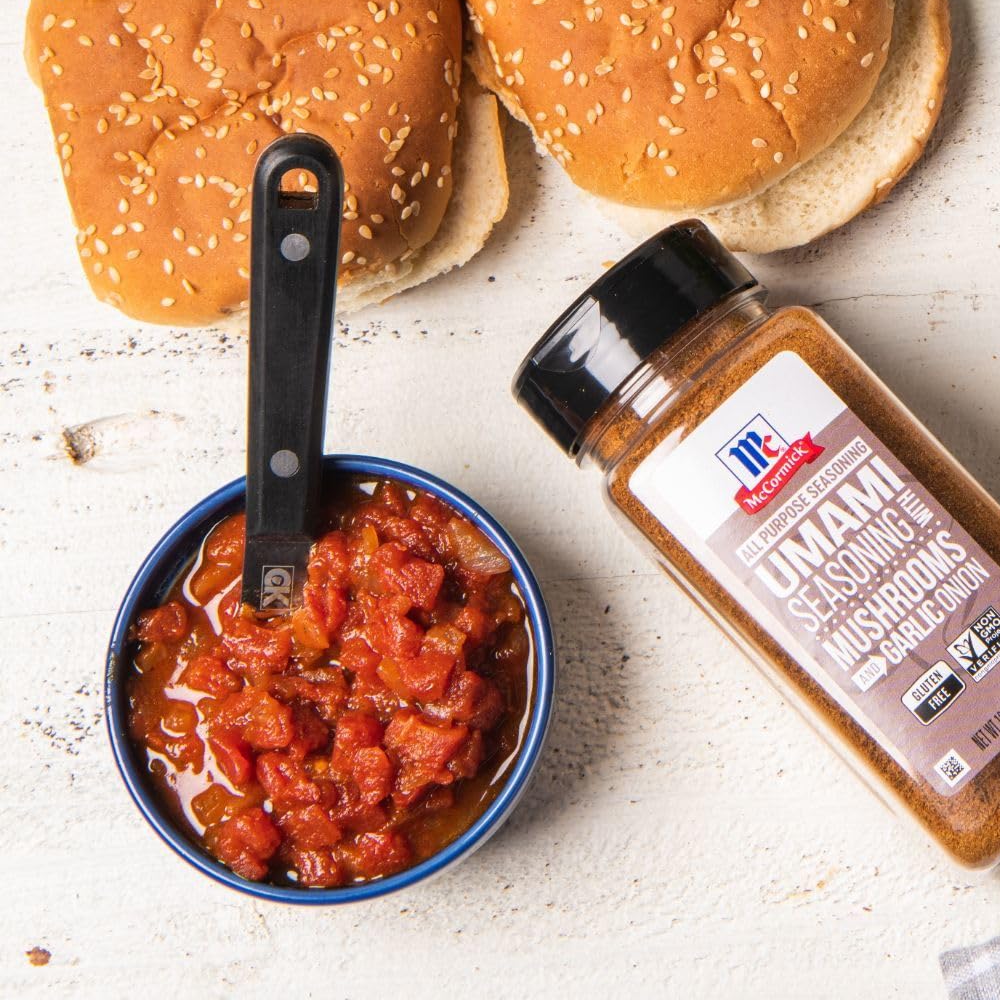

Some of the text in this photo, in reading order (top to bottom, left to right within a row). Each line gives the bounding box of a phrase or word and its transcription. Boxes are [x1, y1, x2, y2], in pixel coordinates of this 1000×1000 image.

[743, 442, 809, 509] McCormick
[742, 440, 868, 562] ALL PURPOSE SEASONING
[896, 489, 934, 528] WITH
[754, 455, 905, 598] UMAMI
[787, 508, 914, 633] SEASONING
[821, 530, 967, 672] MUSHROOMS
[879, 557, 991, 665] GARLIC ONION
[973, 610, 996, 632] NON
[980, 618, 1000, 638] GMO
[859, 662, 881, 685] AND
[912, 670, 943, 701] GLUTEN
[928, 687, 951, 710] FREE
[971, 729, 991, 751] NET
